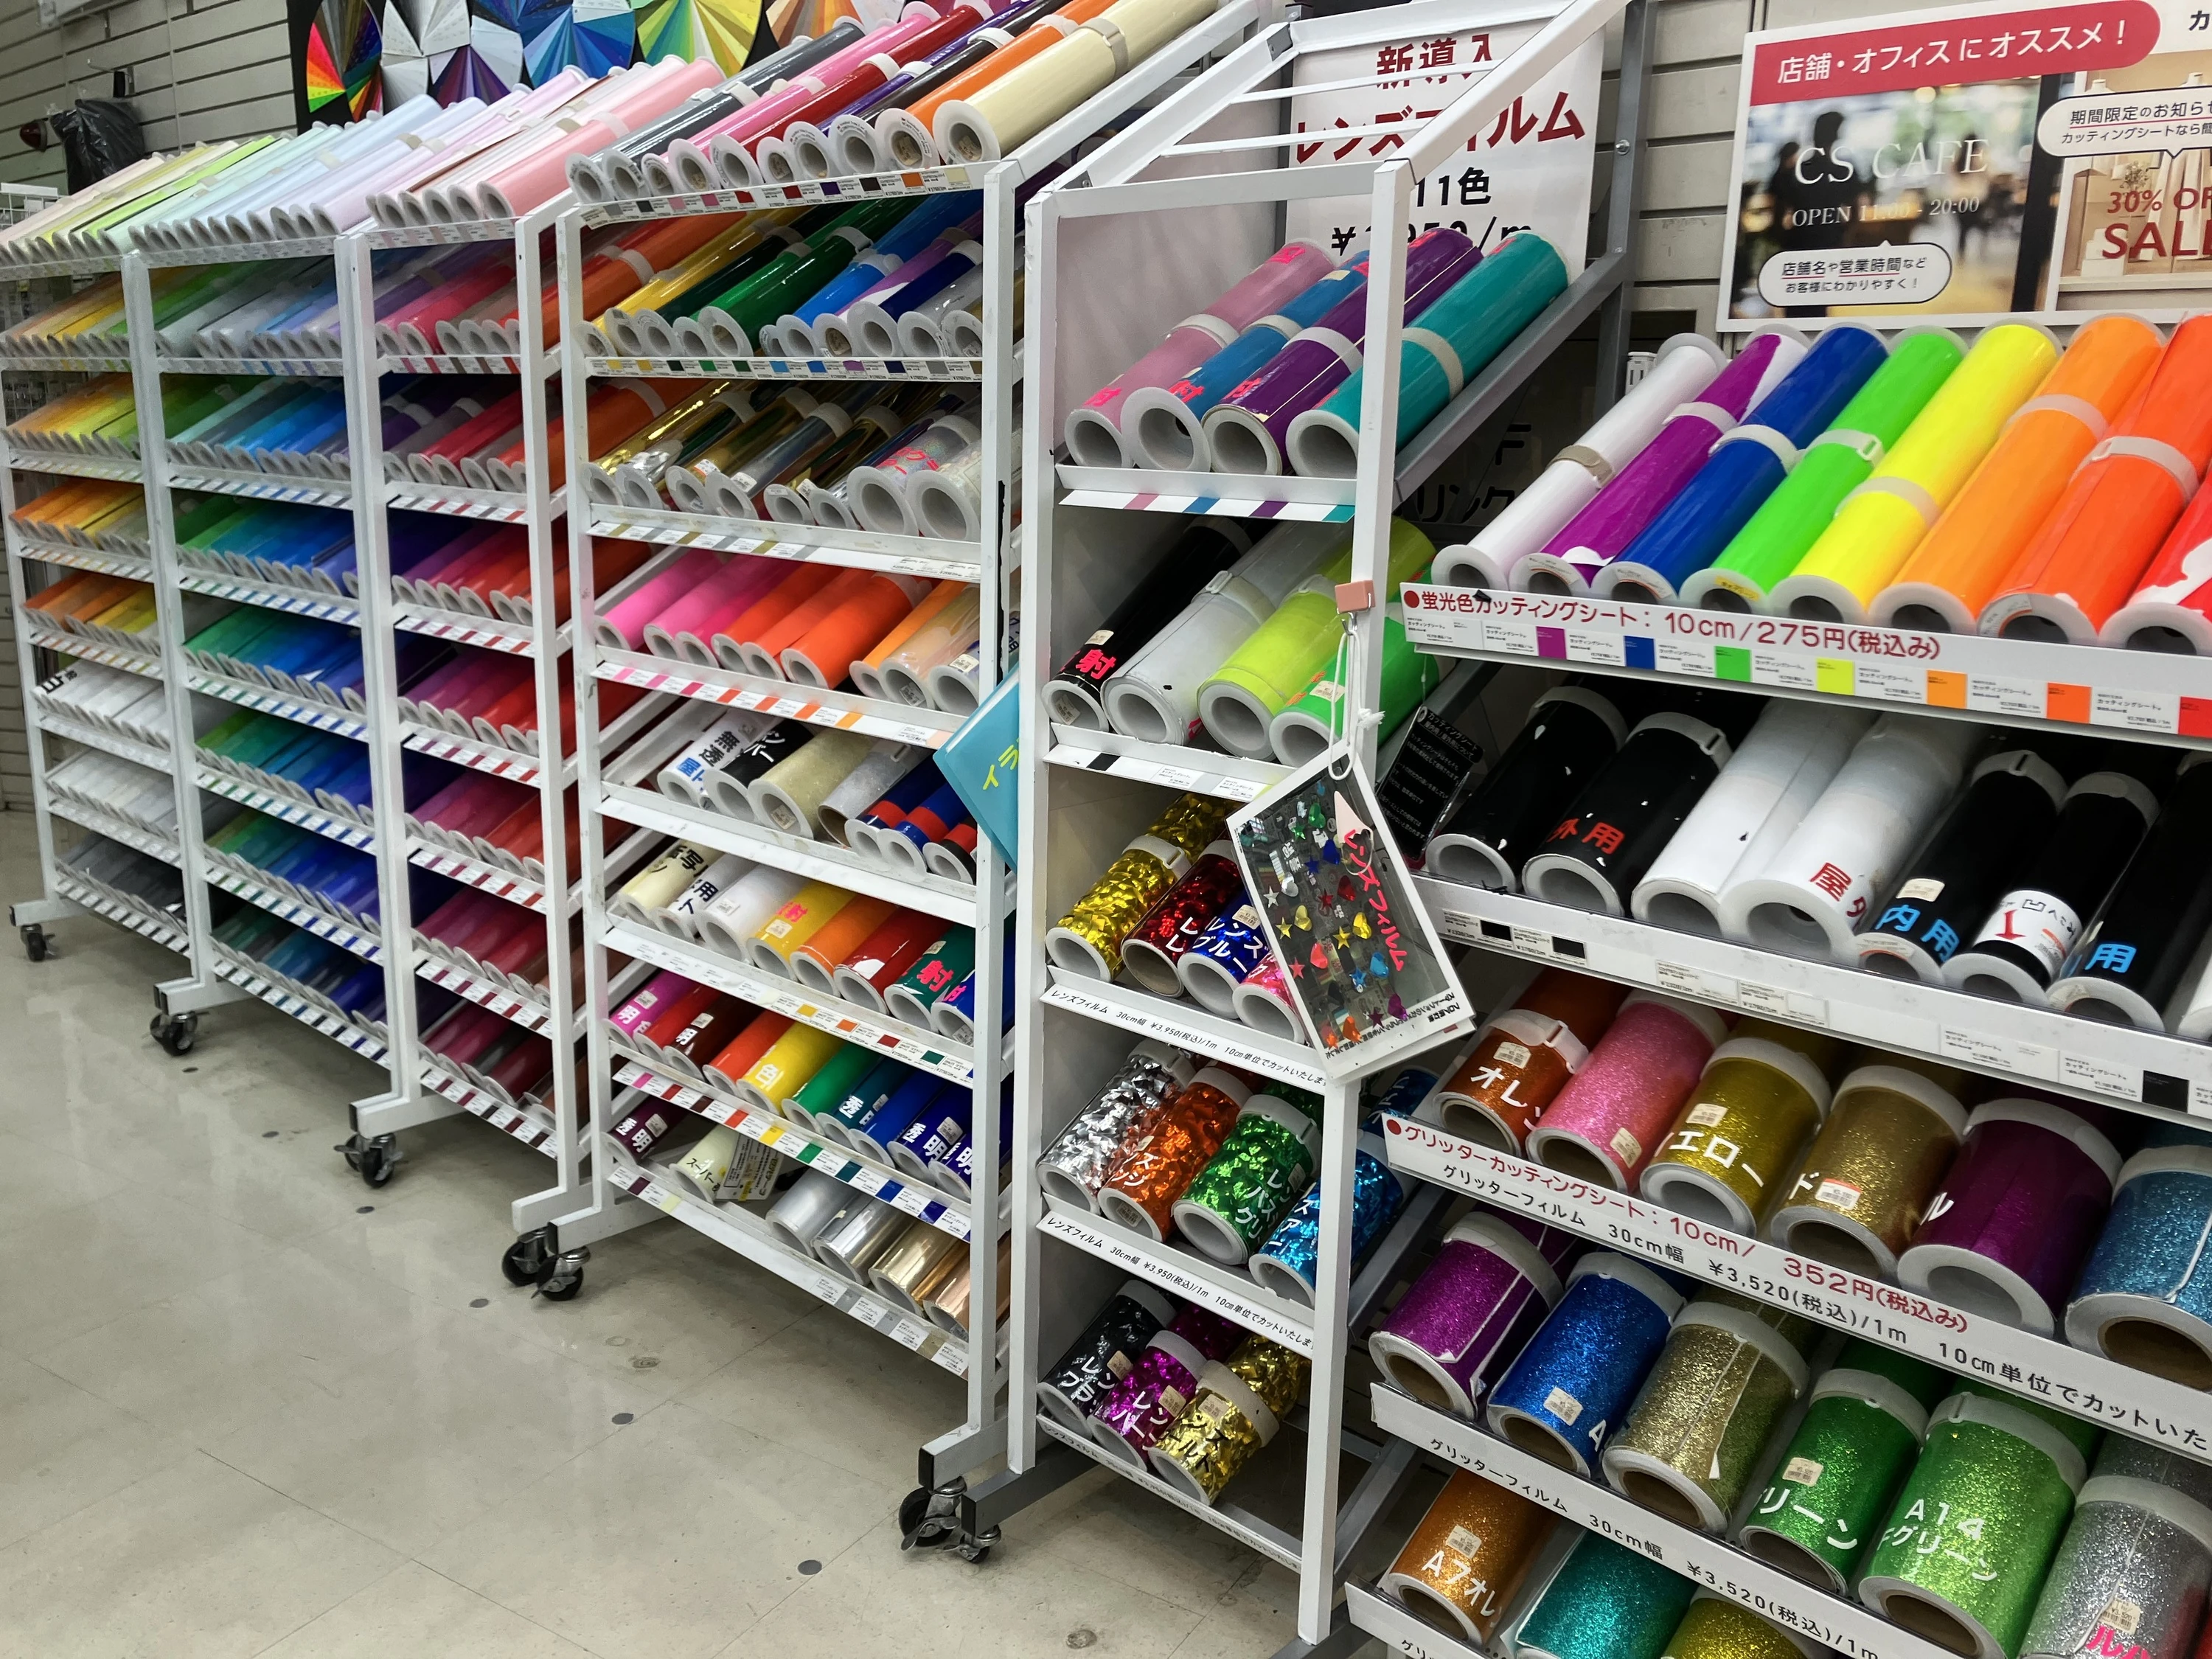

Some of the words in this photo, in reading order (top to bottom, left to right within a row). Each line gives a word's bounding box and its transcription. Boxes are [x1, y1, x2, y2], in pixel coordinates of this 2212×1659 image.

[1777, 20, 2125, 84] 店舗・オフィスにオススメ！
[1795, 146, 1854, 186] CS
[1872, 139, 1989, 180] CAFE
[1792, 204, 1851, 227] OPEN
[1930, 196, 1980, 217] 20:00
[2107, 189, 2162, 214] 30%
[1781, 257, 1927, 276] 店舗名や営業時間など
[1062, 650, 1116, 679] 射
[982, 737, 1019, 790] イラ
[902, 957, 954, 992] 射
[2059, 944, 2137, 978] 用
[1051, 990, 1107, 1014] レンズフィルム
[1116, 1012, 1146, 1027] 30cm幅
[1654, 1130, 1764, 1188] エロー
[1444, 1164, 1586, 1226] グリッターフィルム
[1609, 1224, 1684, 1264] 30cm幅
[1708, 1259, 1907, 1343] ¥3,520(税込)/1m
[1048, 1218, 1102, 1249] レンズフィルム
[1110, 1246, 1141, 1265] 30cm幅
[1216, 1296, 1314, 1349] 10cm単位でカットいたしま
[1430, 1439, 1568, 1513] グリッターフィルム
[1589, 1514, 1663, 1562] 30cm幅
